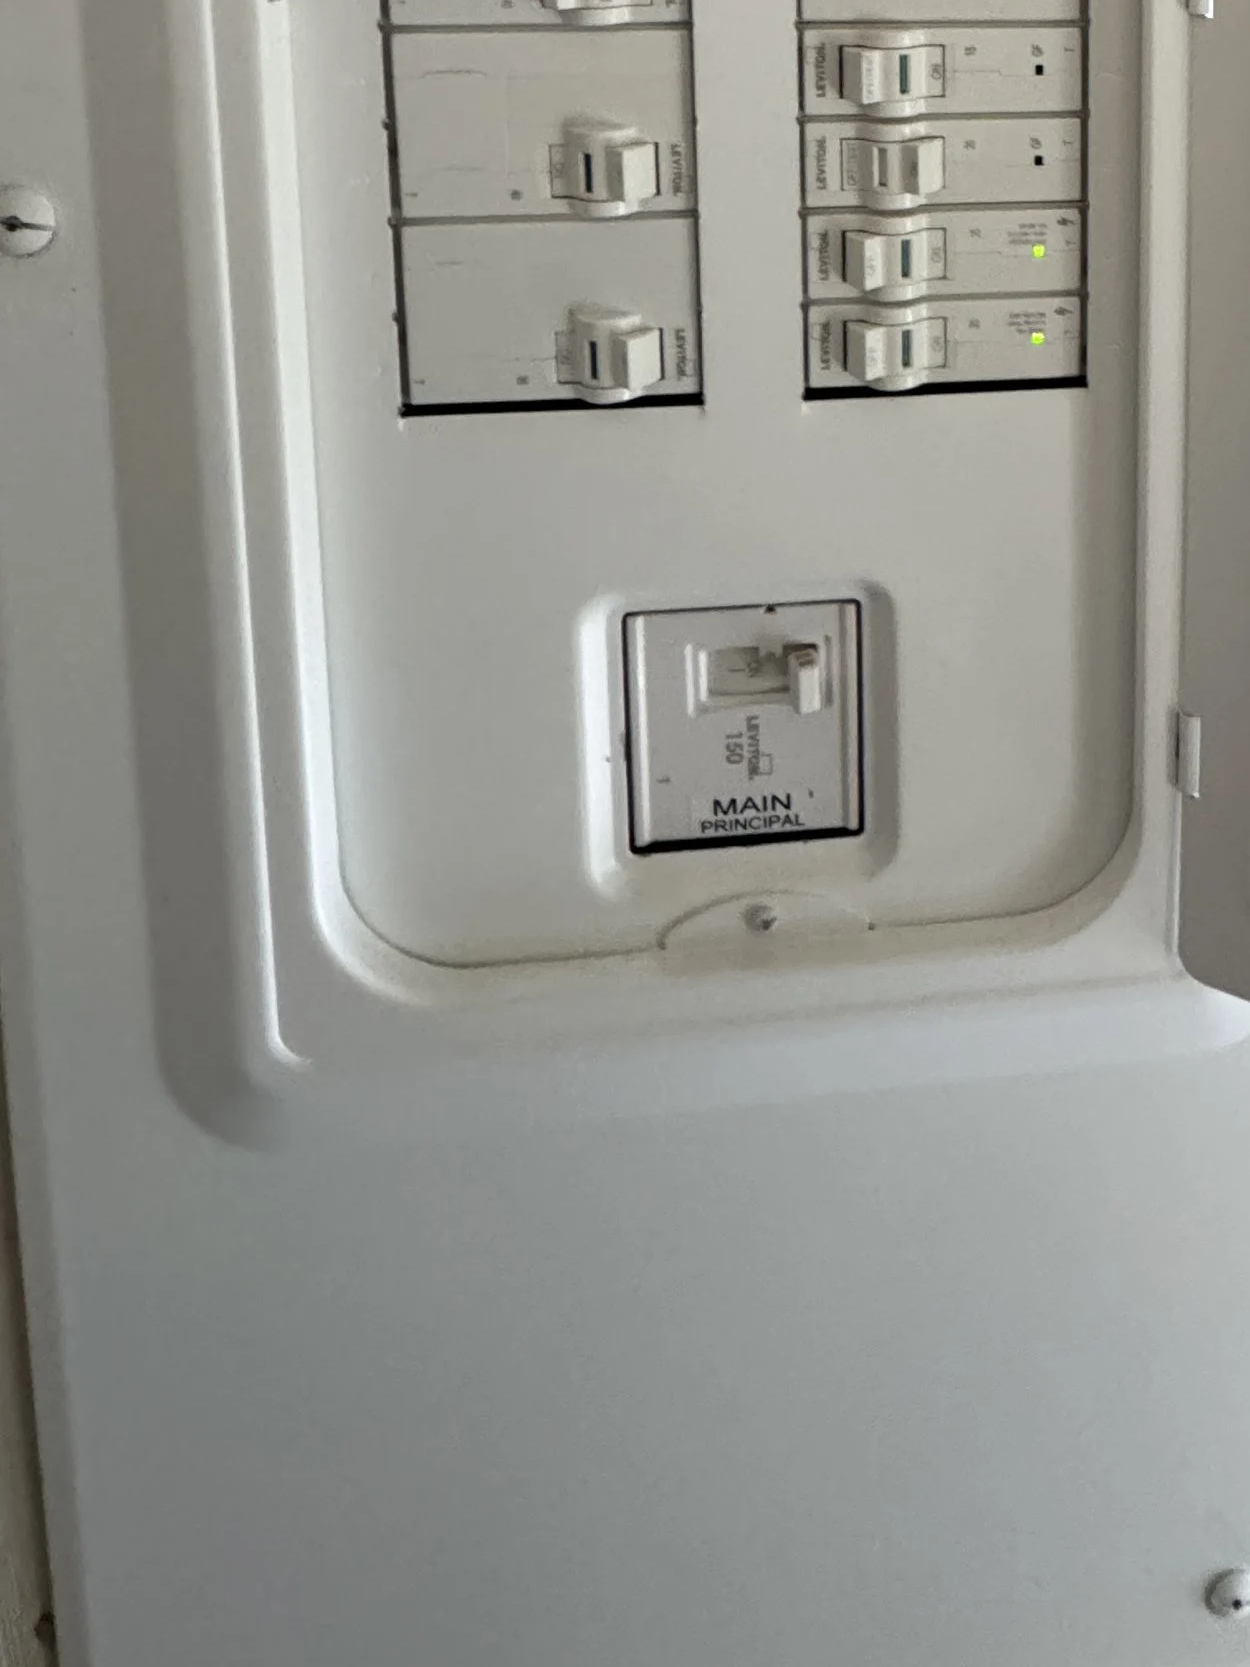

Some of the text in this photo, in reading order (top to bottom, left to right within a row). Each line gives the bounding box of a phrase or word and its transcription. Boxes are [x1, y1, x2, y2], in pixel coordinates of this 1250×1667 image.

[724, 732, 745, 765] 150
[712, 793, 792, 816] MAIN
[700, 813, 806, 834] PRINCIPAL
